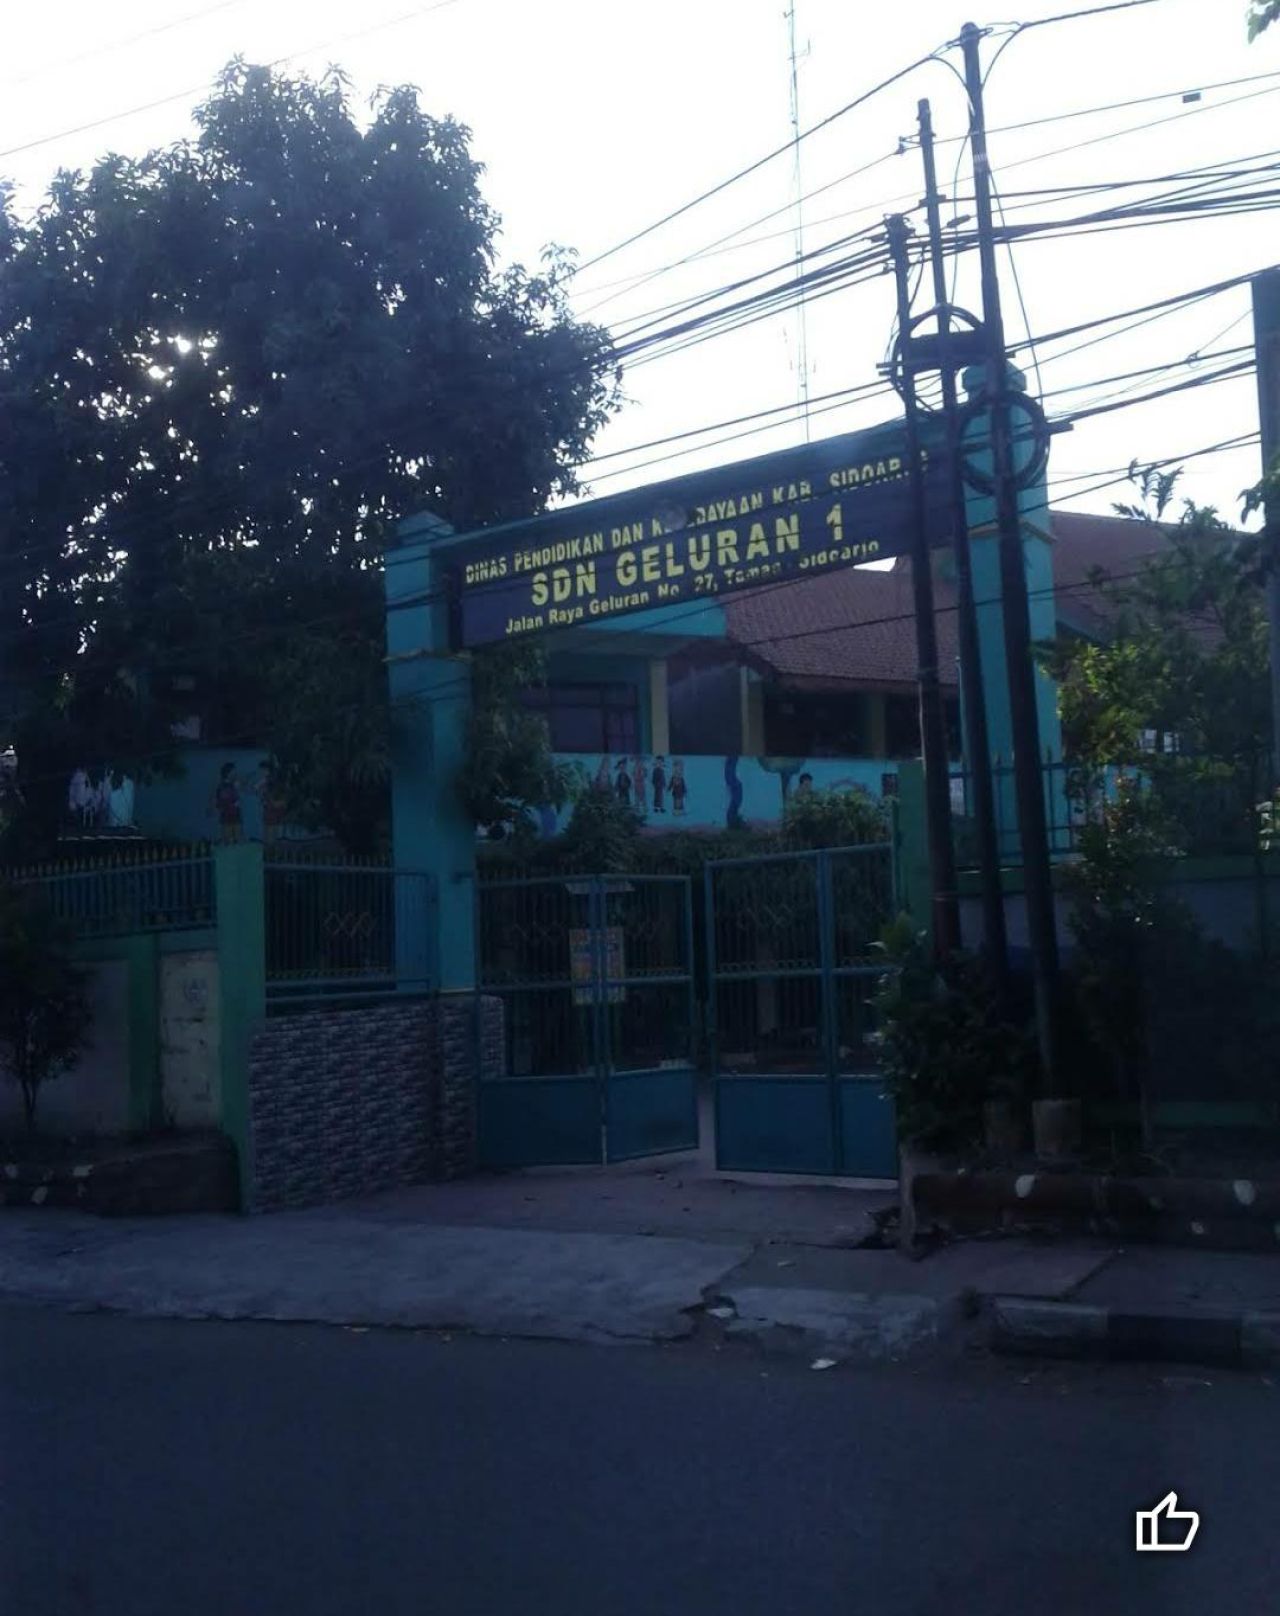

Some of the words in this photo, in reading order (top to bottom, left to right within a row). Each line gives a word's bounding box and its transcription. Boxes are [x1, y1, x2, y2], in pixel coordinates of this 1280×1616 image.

[465, 556, 508, 584] DINAS
[513, 532, 604, 573] PENDIDIKAN
[611, 522, 644, 549] DAN
[532, 561, 597, 607] SDN
[615, 513, 801, 588] GELURAN
[826, 503, 844, 542] 1
[505, 614, 544, 635] Jalan
[548, 605, 584, 625] Raya
[588, 591, 650, 616] Geluran
